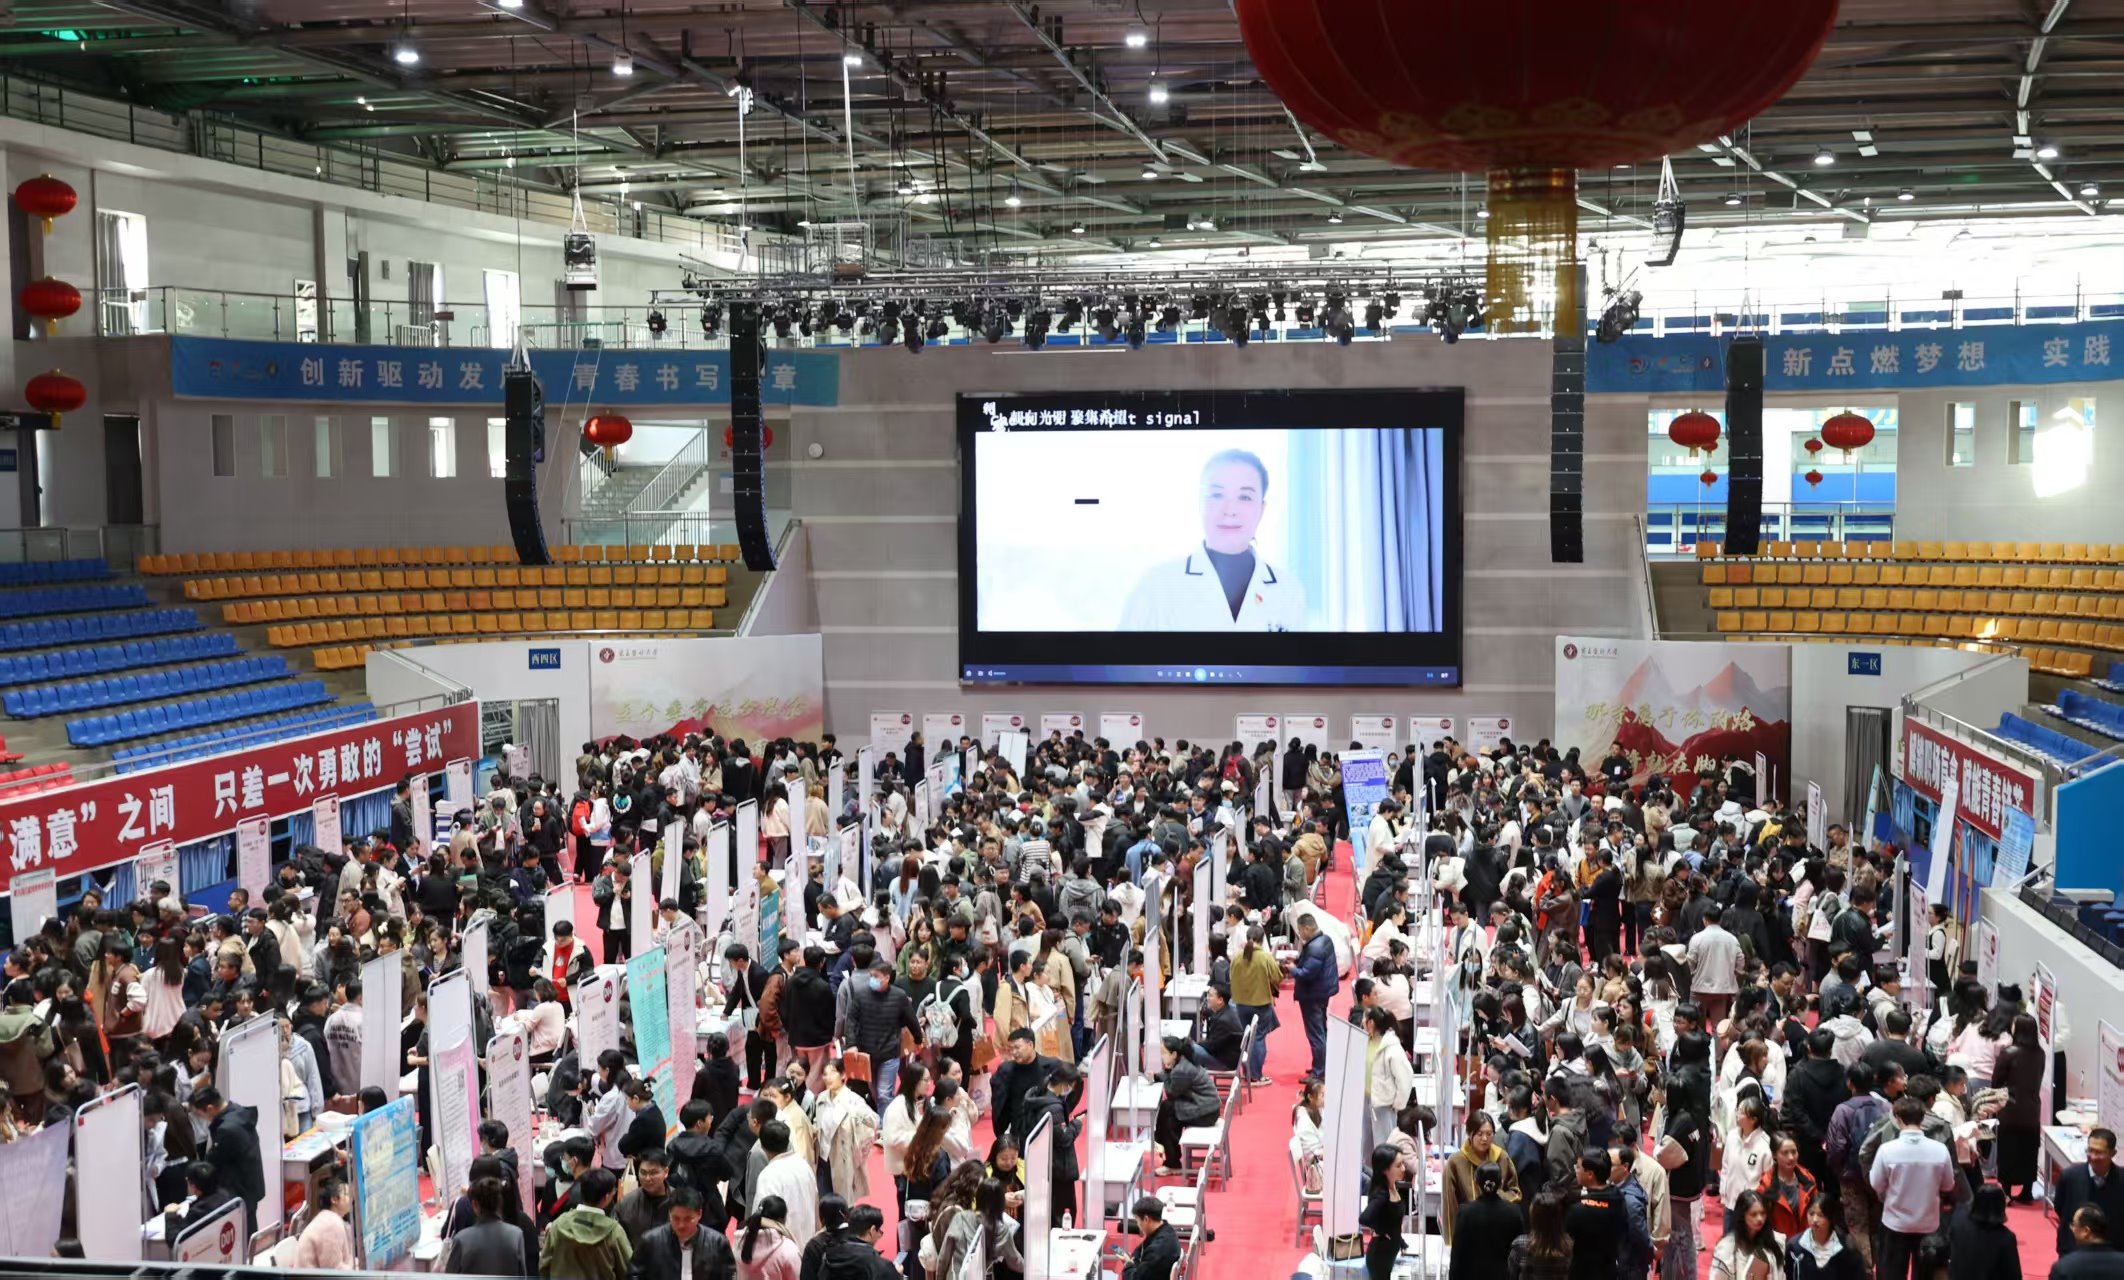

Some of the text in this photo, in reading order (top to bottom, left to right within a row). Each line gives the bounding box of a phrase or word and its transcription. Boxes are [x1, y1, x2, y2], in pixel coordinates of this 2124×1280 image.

[1763, 334, 2111, 377] 新点燃梦想 实践
[574, 362, 796, 392] 青春书写章
[1146, 410, 1200, 428] signal
[1850, 657, 1879, 671] 东一区
[1747, 1152, 1758, 1167] G
